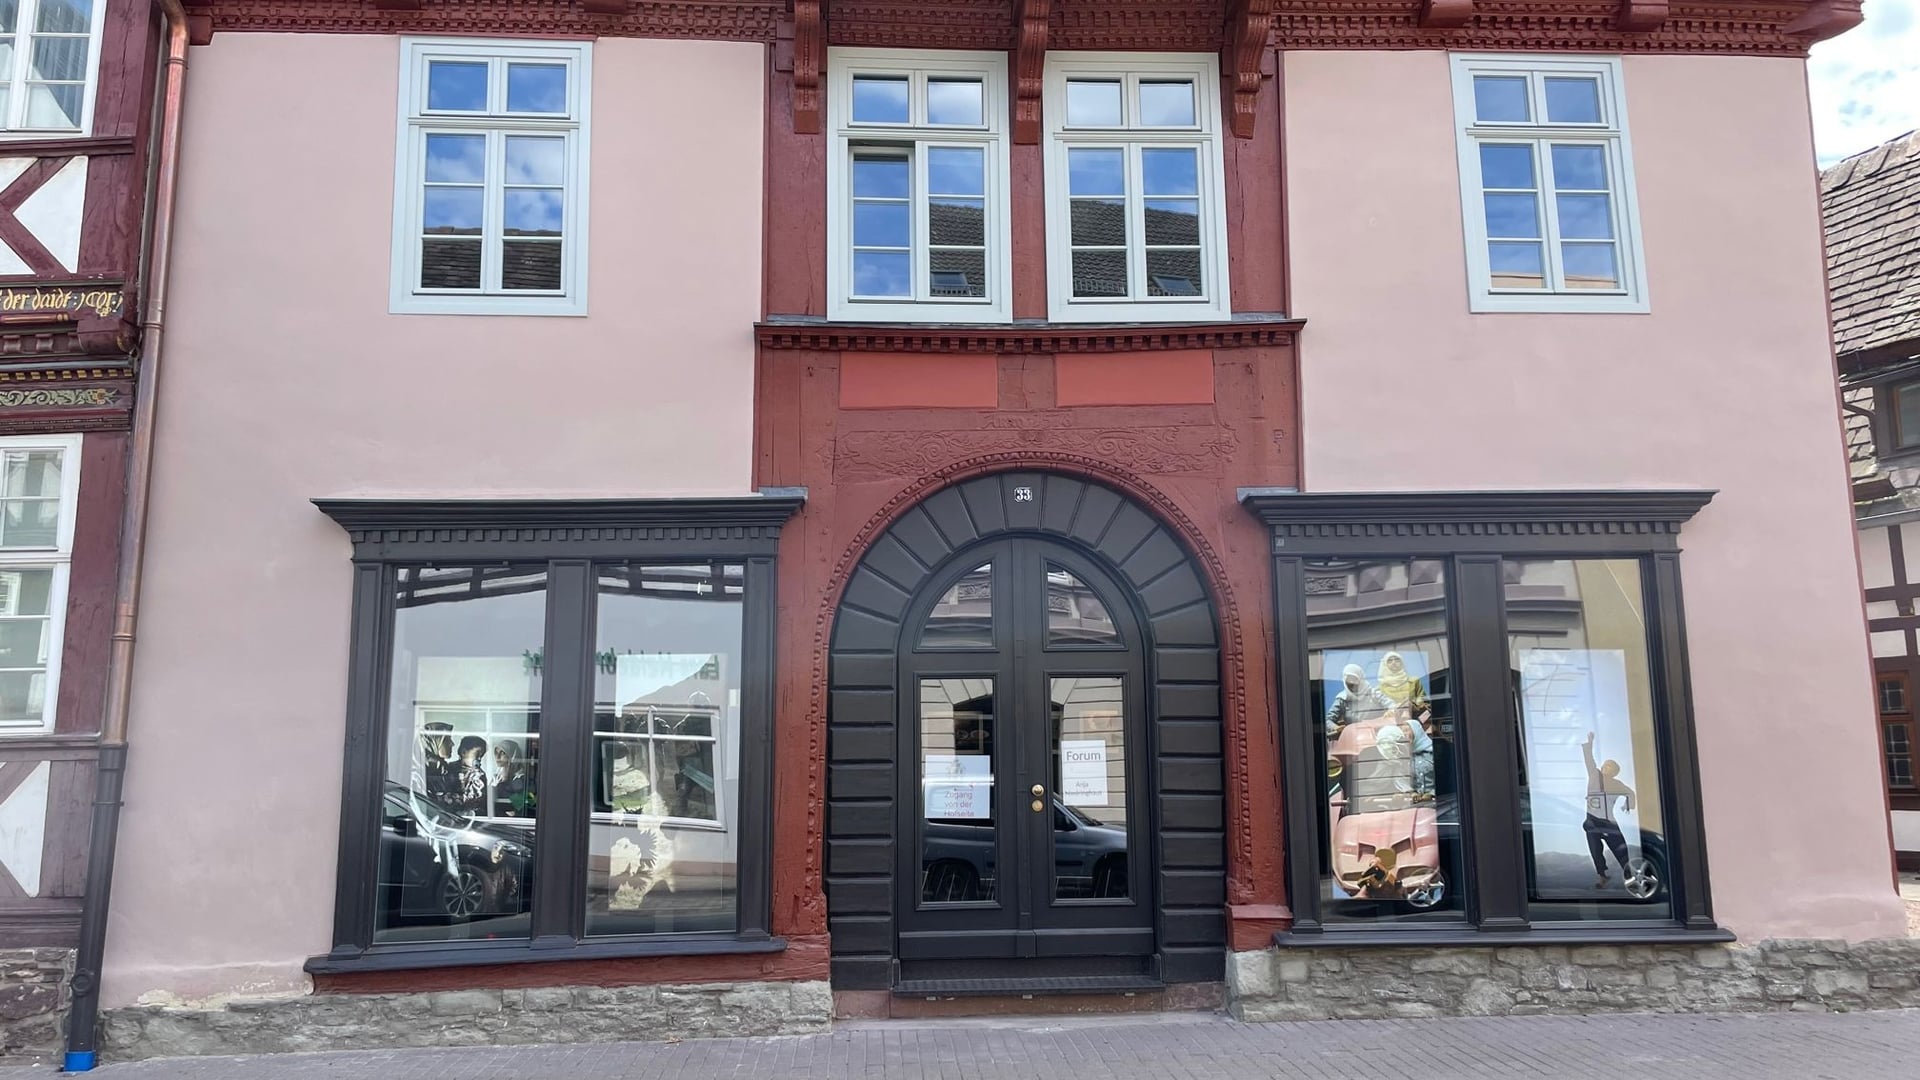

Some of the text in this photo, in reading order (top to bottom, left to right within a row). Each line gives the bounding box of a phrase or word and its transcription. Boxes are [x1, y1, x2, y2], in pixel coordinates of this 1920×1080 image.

[3, 288, 30, 311] der
[1016, 489, 1031, 501] 33
[1066, 750, 1101, 761] Forum
[944, 791, 973, 800] Zugang
[960, 800, 973, 808] der
